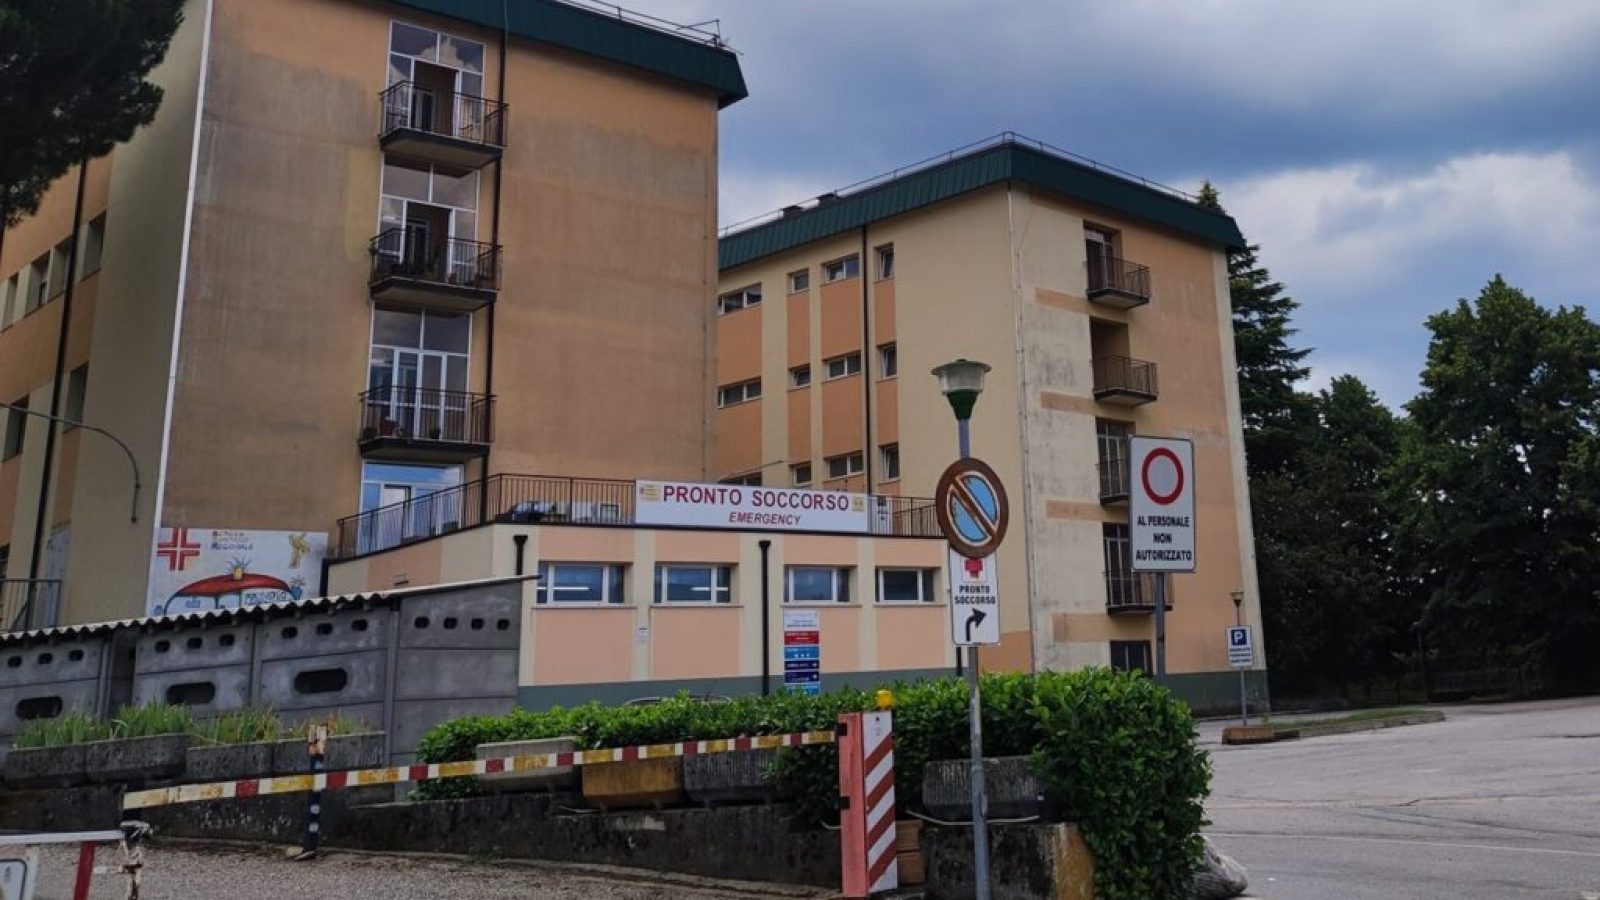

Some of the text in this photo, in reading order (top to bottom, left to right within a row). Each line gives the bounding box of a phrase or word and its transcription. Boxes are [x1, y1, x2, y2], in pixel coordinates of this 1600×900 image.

[663, 485, 849, 511] PRONTO SOCCORSO
[729, 512, 802, 525] EMERGENCY
[1137, 515, 1190, 527] AL PERSONALE
[1152, 533, 1172, 544] NON
[1136, 549, 1192, 561] AUTORIZZATO
[959, 585, 990, 593] PRONTO
[954, 596, 996, 605] SOCCORSO
